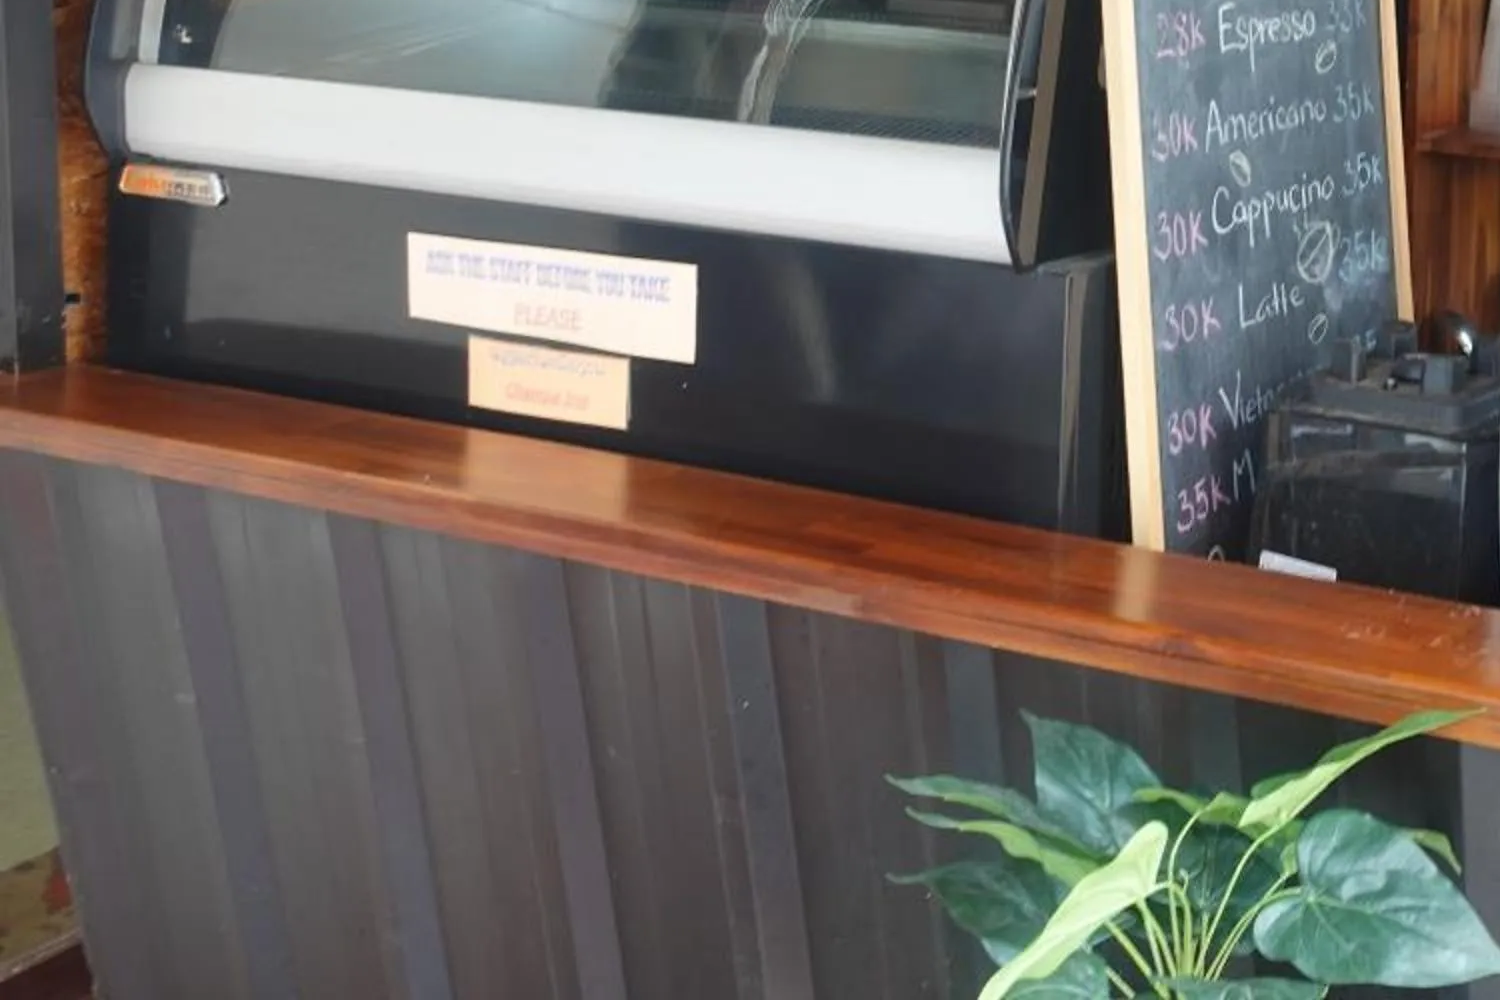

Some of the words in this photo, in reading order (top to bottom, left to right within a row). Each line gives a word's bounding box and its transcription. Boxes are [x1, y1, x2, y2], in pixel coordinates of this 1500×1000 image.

[1217, 1, 1317, 73] Espresso
[1205, 94, 1328, 154] Americano
[1211, 171, 1336, 249] Cappucino
[513, 301, 584, 332] PLEASE
[1238, 282, 1305, 330] Latte
